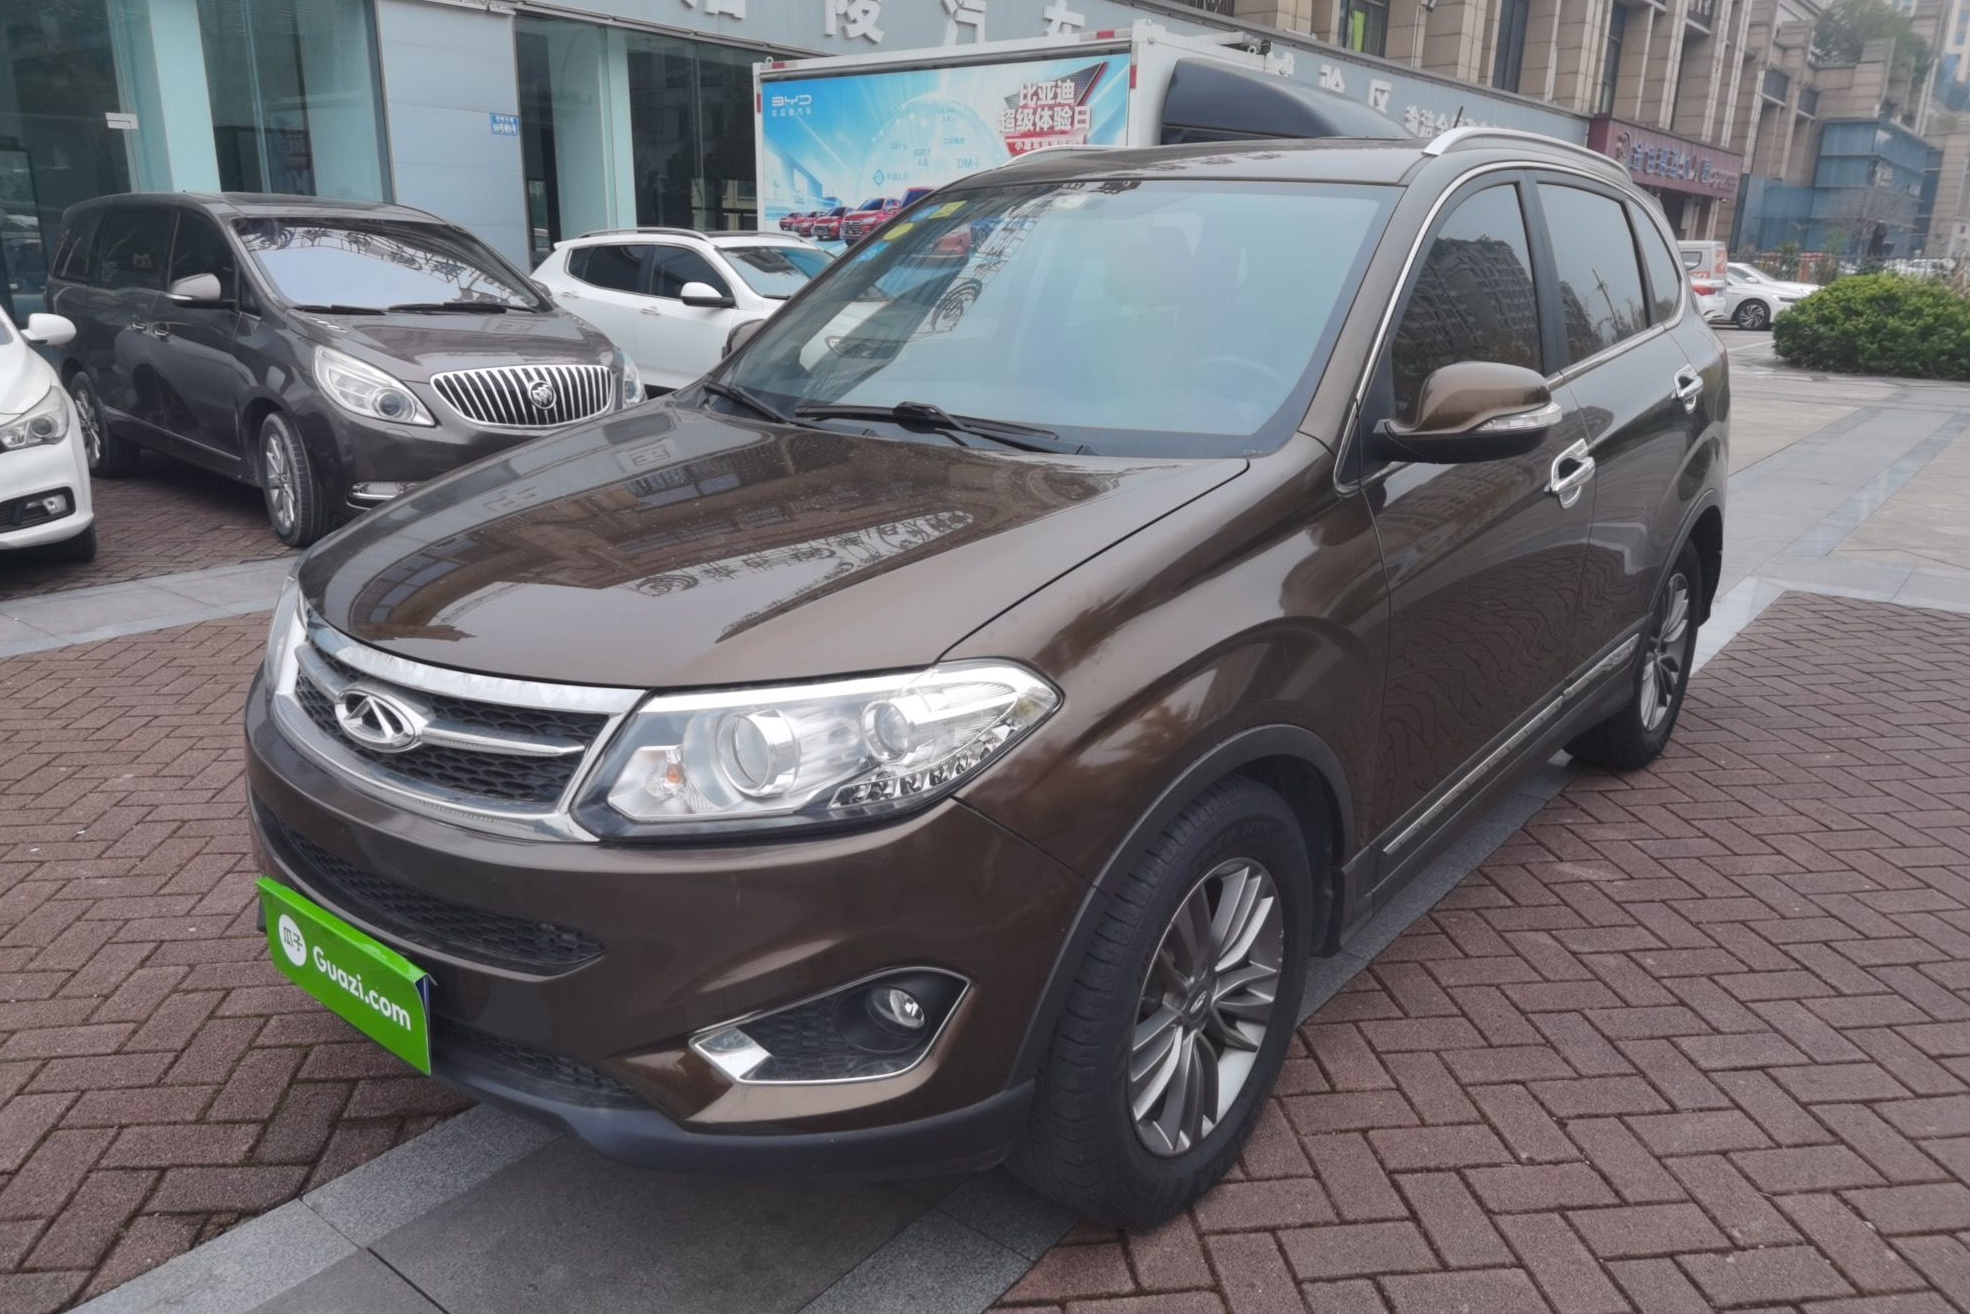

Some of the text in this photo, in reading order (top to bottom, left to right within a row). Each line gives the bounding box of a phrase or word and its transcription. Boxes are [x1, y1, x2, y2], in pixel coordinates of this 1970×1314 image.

[772, 94, 812, 107] BYD
[1020, 79, 1075, 105] 比亚迪
[1001, 105, 1091, 132] 超级体验日
[283, 925, 303, 952] 瓜子
[313, 945, 411, 1031] Guazi.com
